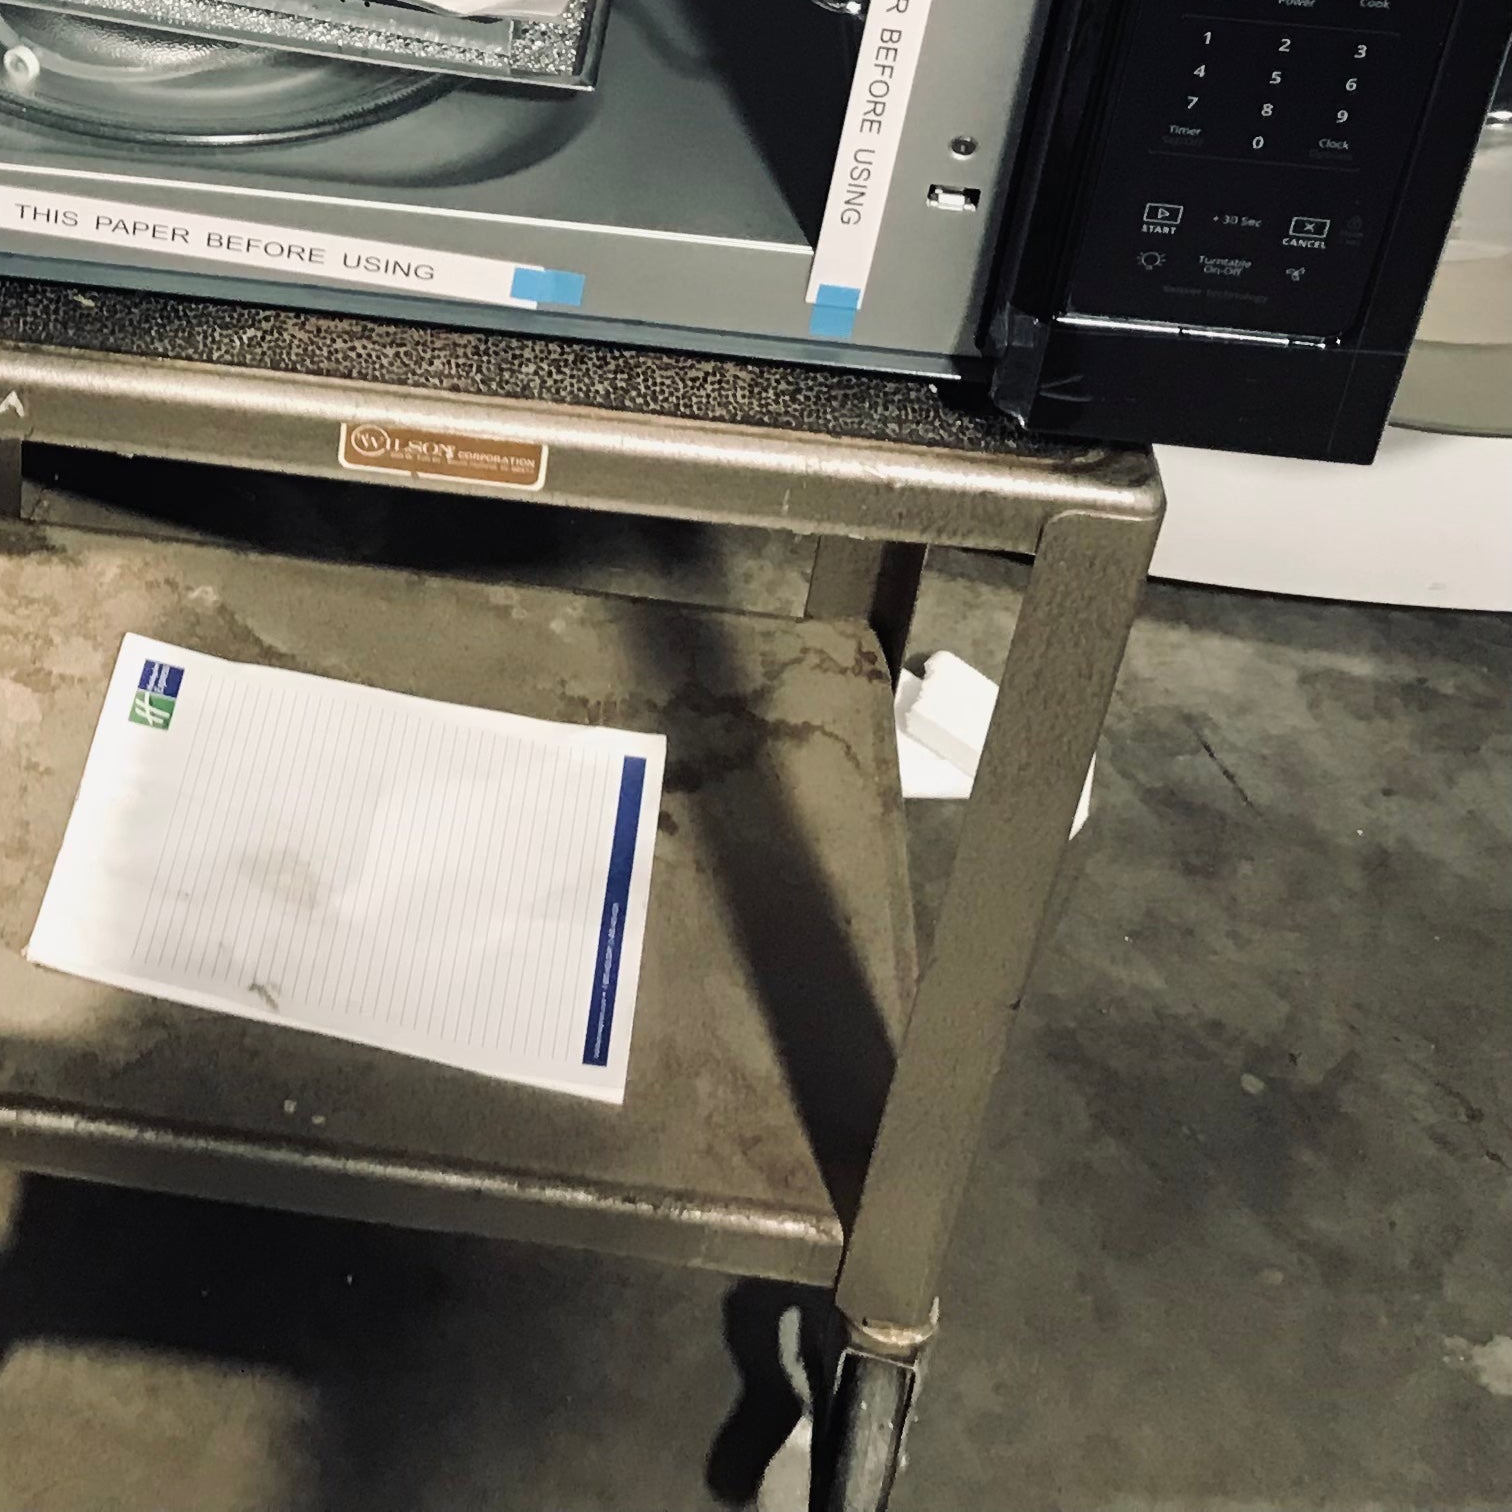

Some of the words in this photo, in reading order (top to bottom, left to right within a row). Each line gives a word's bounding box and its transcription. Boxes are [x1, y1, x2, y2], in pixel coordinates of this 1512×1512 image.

[1203, 31, 1212, 45] 1
[1278, 38, 1291, 53] 2
[1354, 44, 1368, 59] 3
[1193, 64, 1206, 78] 4
[1269, 71, 1282, 85] 5
[859, 28, 902, 135] BEFORE
[1345, 78, 1358, 92] 6
[1187, 95, 1199, 110] 7
[1261, 103, 1274, 117] 8
[1335, 109, 1348, 124] 9
[1169, 124, 1202, 136] Timer
[1252, 135, 1264, 150] 0
[1318, 138, 1349, 151] Clock
[840, 148, 875, 226] USING
[1223, 215, 1238, 225] 30
[1241, 216, 1263, 228] Sec
[1141, 224, 1177, 235] START
[14, 202, 79, 228] THIS
[95, 215, 190, 245] PAPER
[206, 232, 326, 265] BEFORE
[342, 253, 436, 283] USING
[1282, 238, 1327, 250] CANCEL
[1199, 255, 1252, 268] Turntable
[459, 451, 535, 468] CORPORATION
